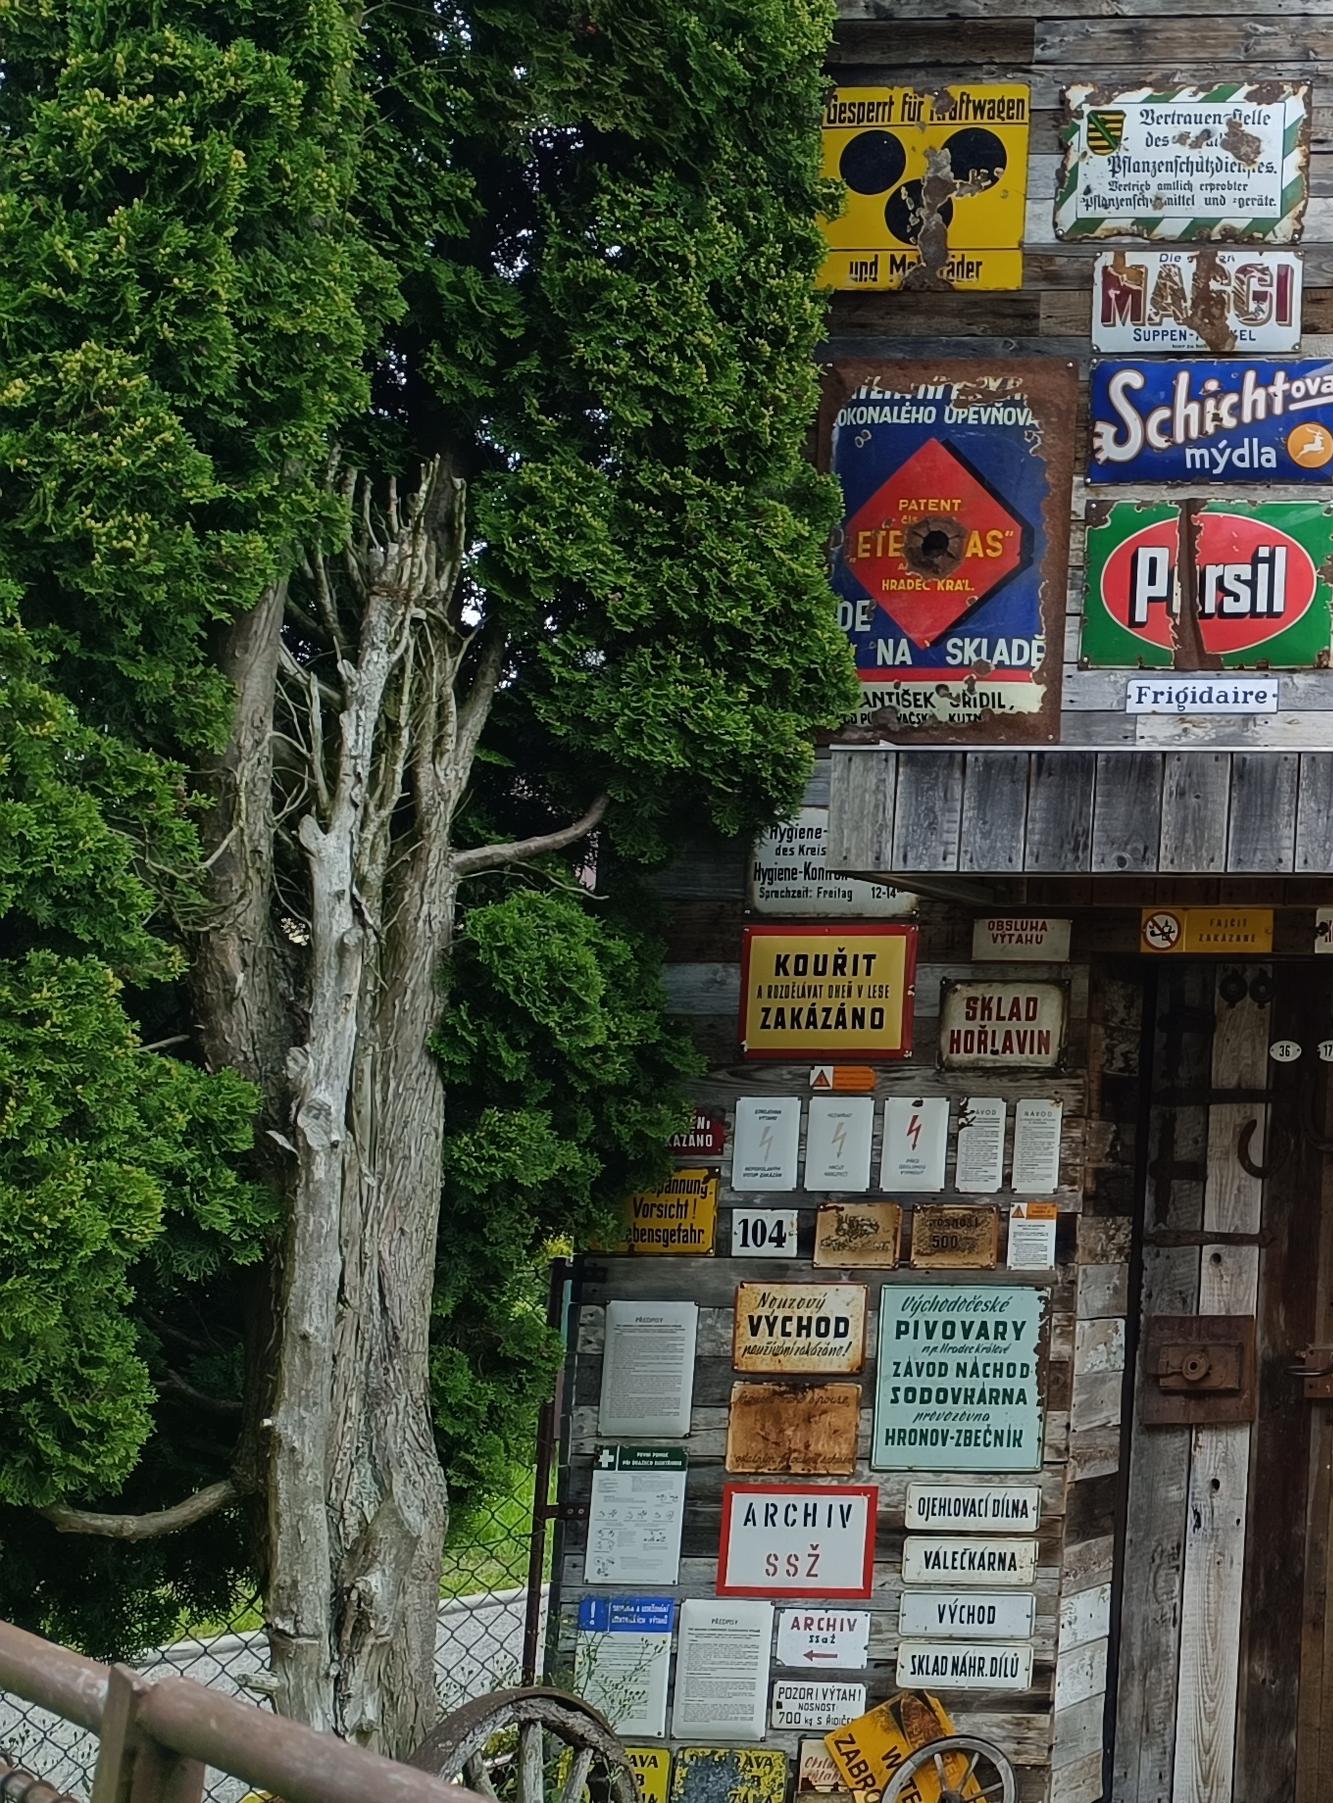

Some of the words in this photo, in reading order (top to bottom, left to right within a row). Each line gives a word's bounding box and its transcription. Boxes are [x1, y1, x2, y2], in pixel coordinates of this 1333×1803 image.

[827, 95, 894, 125] Gesperrt
[900, 93, 924, 123] für
[1205, 195, 1226, 207] und
[1101, 263, 1294, 327] MAGI
[1186, 438, 1278, 474] mýdla
[899, 499, 962, 512] PATENT
[882, 579, 931, 592] HRADEC
[1132, 546, 1288, 626] Prsil
[876, 638, 913, 666] NA
[1136, 684, 1269, 707] Frigidaire
[775, 845, 794, 857] des
[817, 886, 853, 902] Freitag
[987, 919, 1048, 932] OBSLUHA
[991, 932, 1044, 945] VÝTAHU
[775, 947, 877, 977] KOUŘIT
[868, 984, 890, 999] LESE
[760, 1002, 885, 1031] ZAKÁZÁNO
[965, 996, 1038, 1022] SKLAD
[950, 1024, 1051, 1056] HOŘLAVIN
[1279, 1045, 1290, 1057] 36
[632, 1197, 690, 1219] Vorsicht
[738, 1217, 787, 1248] 104
[757, 1291, 827, 1313] Nouzový
[901, 1294, 1010, 1319] Východočeské
[748, 1309, 850, 1339] VÝCHOD
[896, 1320, 1027, 1341] PIVOVARY
[892, 1355, 949, 1379] ZÁVOD
[956, 1356, 1031, 1379] NÁCHOD
[890, 1381, 1028, 1406] SODOVKÁRNA
[912, 1411, 991, 1424] provozovna
[885, 1424, 1024, 1449] HRONOV-ZBEČNÍK
[743, 1501, 854, 1529] ARCHIV
[918, 1492, 989, 1522] OJEHLOVACÍ
[991, 1491, 1029, 1520] DÍLNA
[765, 1543, 821, 1578] SSŽ
[923, 1545, 1018, 1571] VÁLEČKÁRNA
[937, 1598, 996, 1624] VÝCHOD
[790, 1616, 858, 1632] ARCHIV
[910, 1654, 948, 1676] SKLAD
[821, 1685, 862, 1702] VÝTAH!
[778, 1711, 801, 1724] 700
[798, 1702, 837, 1711] NOSNOST
